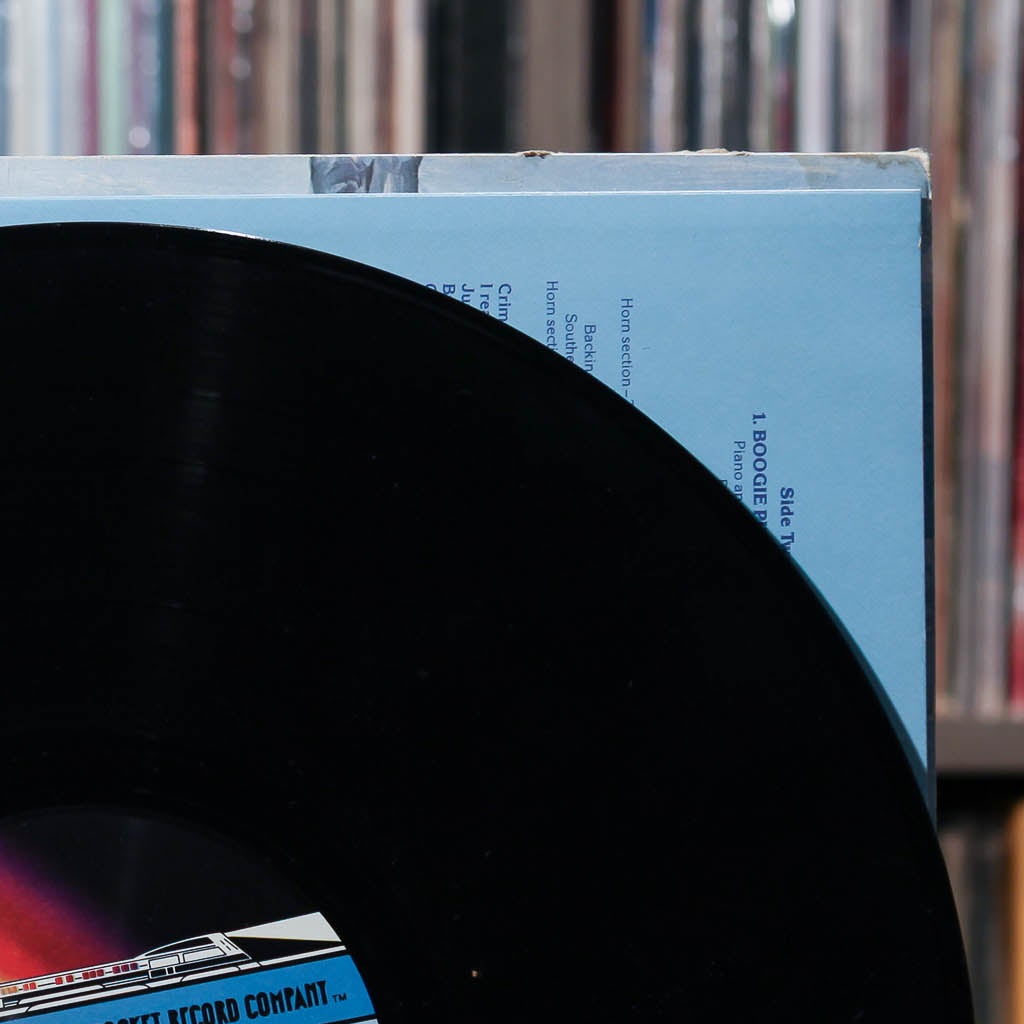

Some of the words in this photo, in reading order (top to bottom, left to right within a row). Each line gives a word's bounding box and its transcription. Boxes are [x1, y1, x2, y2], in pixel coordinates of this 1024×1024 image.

[546, 281, 558, 315] Horn
[621, 298, 633, 332] Horn
[621, 336, 633, 387] section
[752, 412, 766, 425] 1.
[734, 441, 746, 480] Piano
[752, 430, 767, 505] BOOGIE
[780, 487, 794, 527] Side
[244, 980, 327, 1019] COMPANY
[333, 993, 346, 1001] TM
